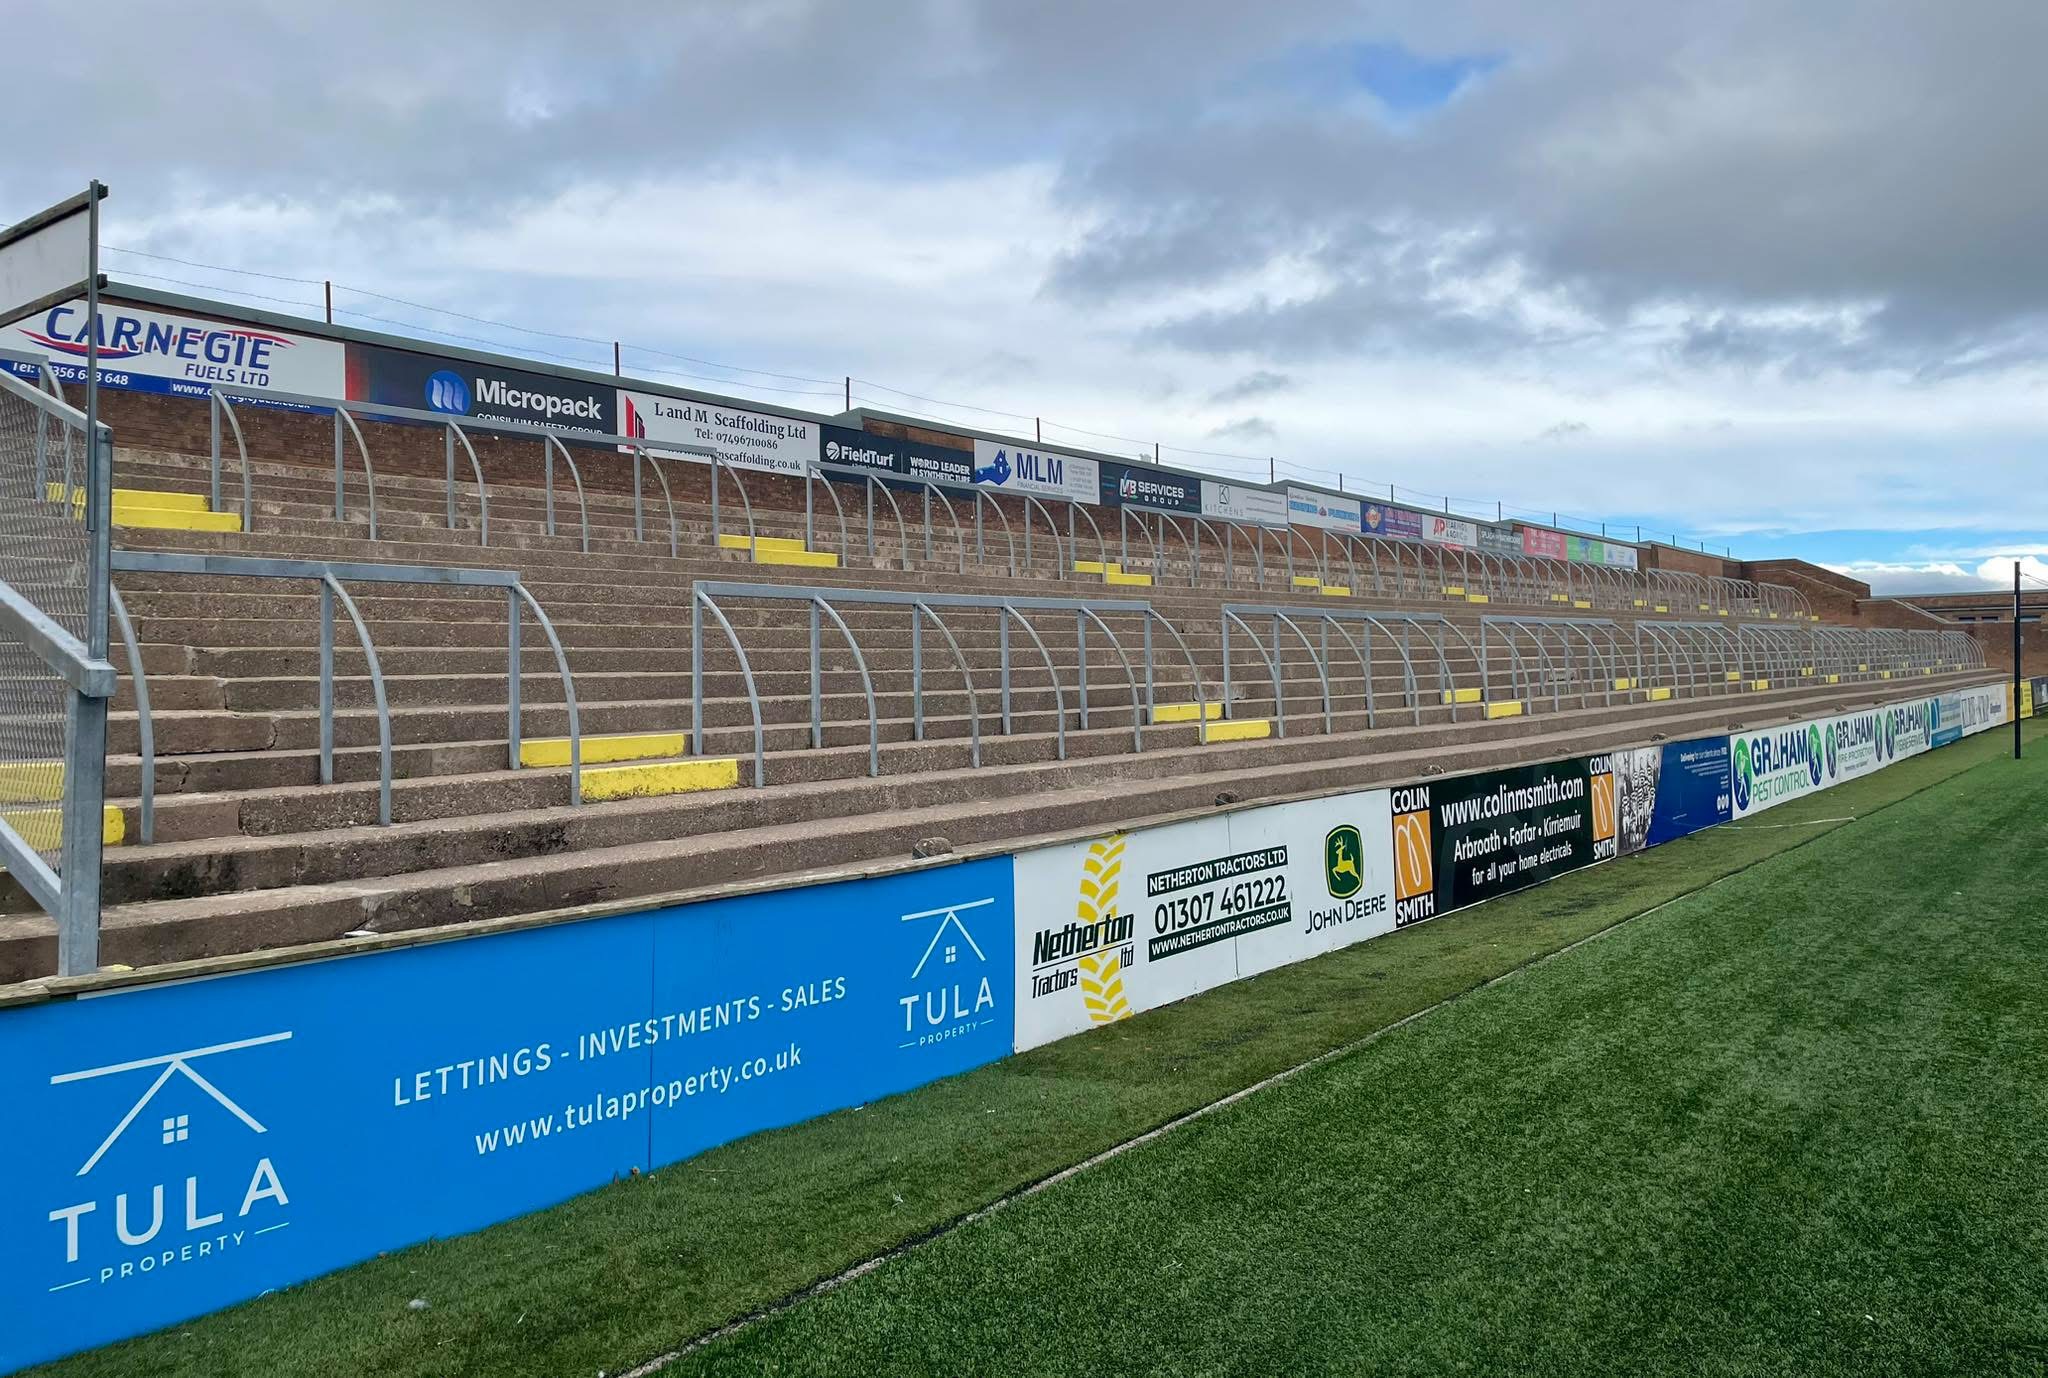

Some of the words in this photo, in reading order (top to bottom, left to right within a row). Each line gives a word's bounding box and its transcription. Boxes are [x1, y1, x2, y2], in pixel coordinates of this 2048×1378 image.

[46, 307, 275, 370] CARNEGIE
[39, 365, 75, 379] 356
[104, 373, 129, 386] 648
[185, 363, 235, 382] FUELS
[240, 371, 269, 386] LTD
[476, 378, 602, 420] Micropack
[666, 406, 691, 421] and
[695, 409, 708, 423] M
[714, 412, 785, 439] Scaffolding
[788, 424, 806, 440] Ltd
[694, 428, 713, 440] Tel:
[716, 432, 778, 449] 07496710086
[841, 446, 894, 467] FieldTurf
[910, 457, 939, 471] WORLD
[941, 460, 971, 475] LEADER
[1016, 452, 1063, 490] MLM
[910, 468, 918, 476] IN
[919, 469, 954, 482] SYNTHETIC
[1138, 481, 1184, 498] SERVICES
[1144, 495, 1180, 506] GROUP
[1205, 504, 1244, 517] KITCHENS
[1836, 715, 1874, 750] GRAHAM
[1590, 755, 1613, 776] COLIN
[1751, 728, 1808, 777] GRAHAM
[1391, 786, 1430, 814] COLIN
[1441, 775, 1584, 828] www.colinmsmith.com
[1753, 778, 1774, 804] PEST
[1774, 768, 1810, 797] CONTROL
[1454, 829, 1501, 862] Arbroath
[1509, 822, 1537, 847] Forfar
[1593, 837, 1615, 861] SMITH
[1149, 864, 1213, 893] NETHERTON
[1214, 853, 1265, 877] TRACTORS
[1267, 849, 1286, 866] LTD
[1472, 867, 1485, 886] for
[1487, 862, 1496, 881] all
[1498, 860, 1517, 883] your
[1518, 854, 1538, 871] home
[1540, 840, 1573, 864] electricals
[1154, 891, 1214, 934] 01307
[1220, 874, 1287, 915] 461222
[1305, 906, 1342, 934] JOHN
[1345, 894, 1386, 921] DEERE
[1396, 892, 1435, 925] SMITH
[1033, 913, 1134, 966] Netherton
[1151, 906, 1290, 955] WWW.NETHERTONTRACTORS.CO.UK
[1120, 945, 1134, 969] ltd
[1032, 968, 1078, 999] Tractors
[900, 976, 994, 1032] TULA
[393, 1042, 551, 1106] LETTINGS
[579, 995, 761, 1061] INVESTMENTS
[781, 976, 847, 1013] SALES
[919, 1021, 977, 1046] PROPERTY
[475, 1042, 802, 1155] www.tulaproperty.co.uk
[49, 1157, 289, 1263] TULA
[100, 1230, 245, 1284] PROPERTY
